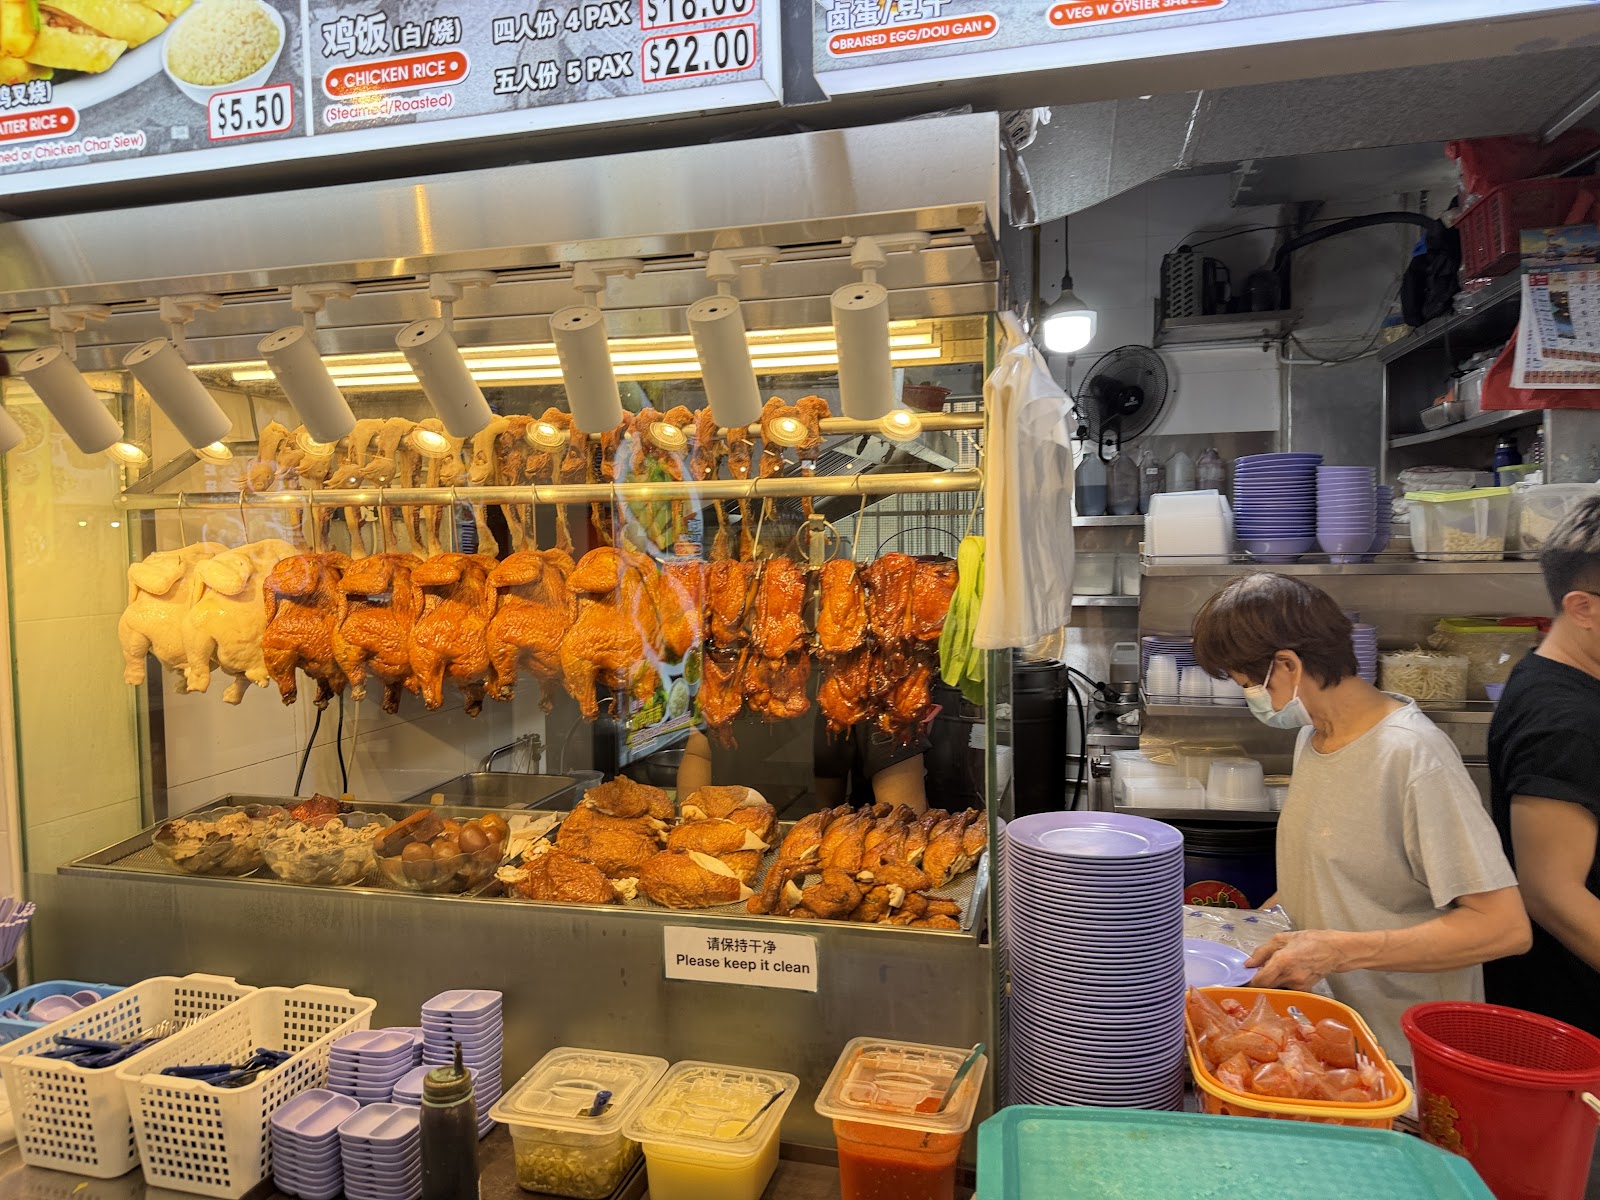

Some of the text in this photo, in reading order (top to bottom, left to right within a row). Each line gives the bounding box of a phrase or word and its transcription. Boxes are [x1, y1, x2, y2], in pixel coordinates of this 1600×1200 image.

[493, 1, 632, 44] 四人份 4 PAX
[1065, 6, 1094, 20] VEG
[1096, 3, 1110, 16] W
[1111, 0, 1160, 14] OYSTER
[322, 11, 462, 57] 鸡饭 (白/烧)
[839, 20, 982, 50] BRAISED EGG/DOU GAN
[650, 29, 748, 79] $22.00
[343, 60, 447, 88] CHICKEN RICE
[494, 52, 633, 94] 五人份 5 PAX
[217, 92, 284, 135] $5.50
[326, 93, 453, 122] (Steamed/Roasted)
[29, 114, 58, 131] RICE
[21, 151, 32, 160] or
[35, 141, 80, 159] Chicken
[84, 138, 111, 152] Char
[114, 133, 144, 148] Siew)
[707, 937, 776, 955] 请保持干净
[676, 954, 810, 974] Please keep it clean
